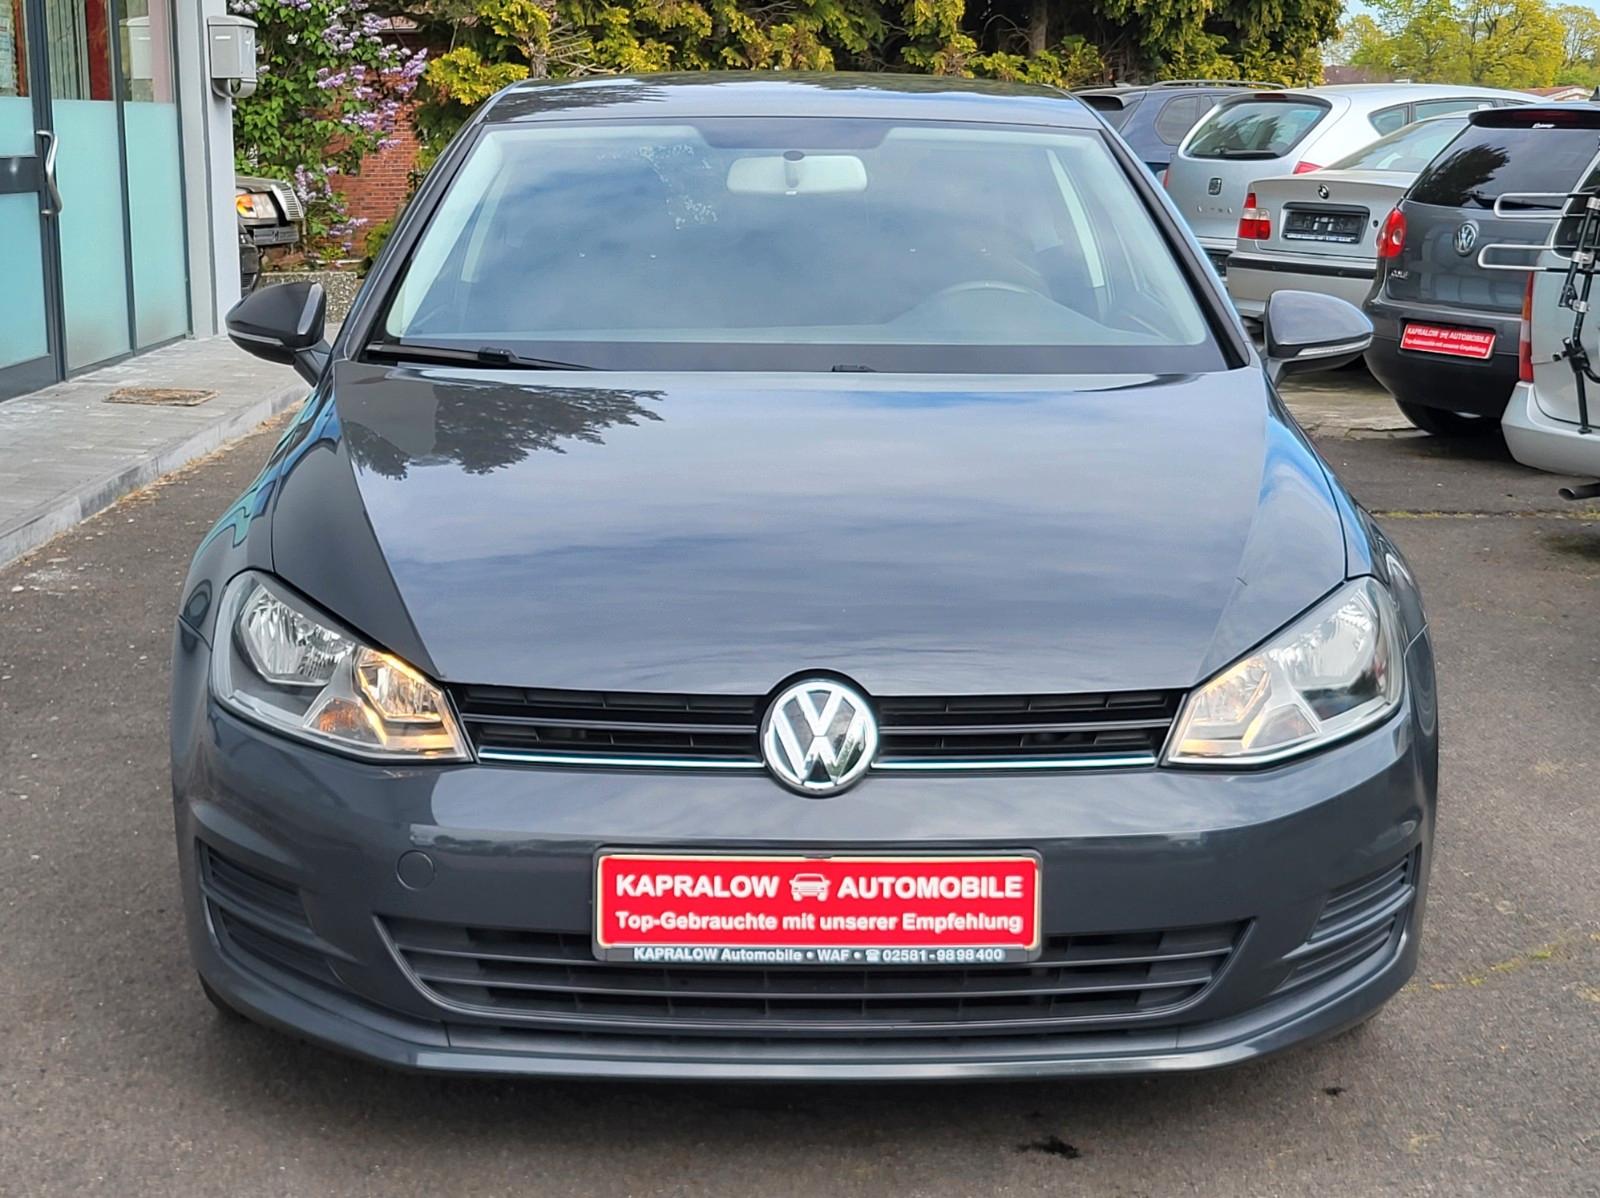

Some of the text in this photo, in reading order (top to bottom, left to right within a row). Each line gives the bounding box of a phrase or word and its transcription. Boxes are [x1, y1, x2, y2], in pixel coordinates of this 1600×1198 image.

[616, 874, 1024, 899] KAPRALOW AUTOMOBILE
[615, 911, 1024, 934] Top-Gebrauchte mit unserer Empfehlung
[634, 948, 719, 961] KAPRALOW
[721, 948, 802, 961] Automobile
[817, 950, 850, 961] WAF
